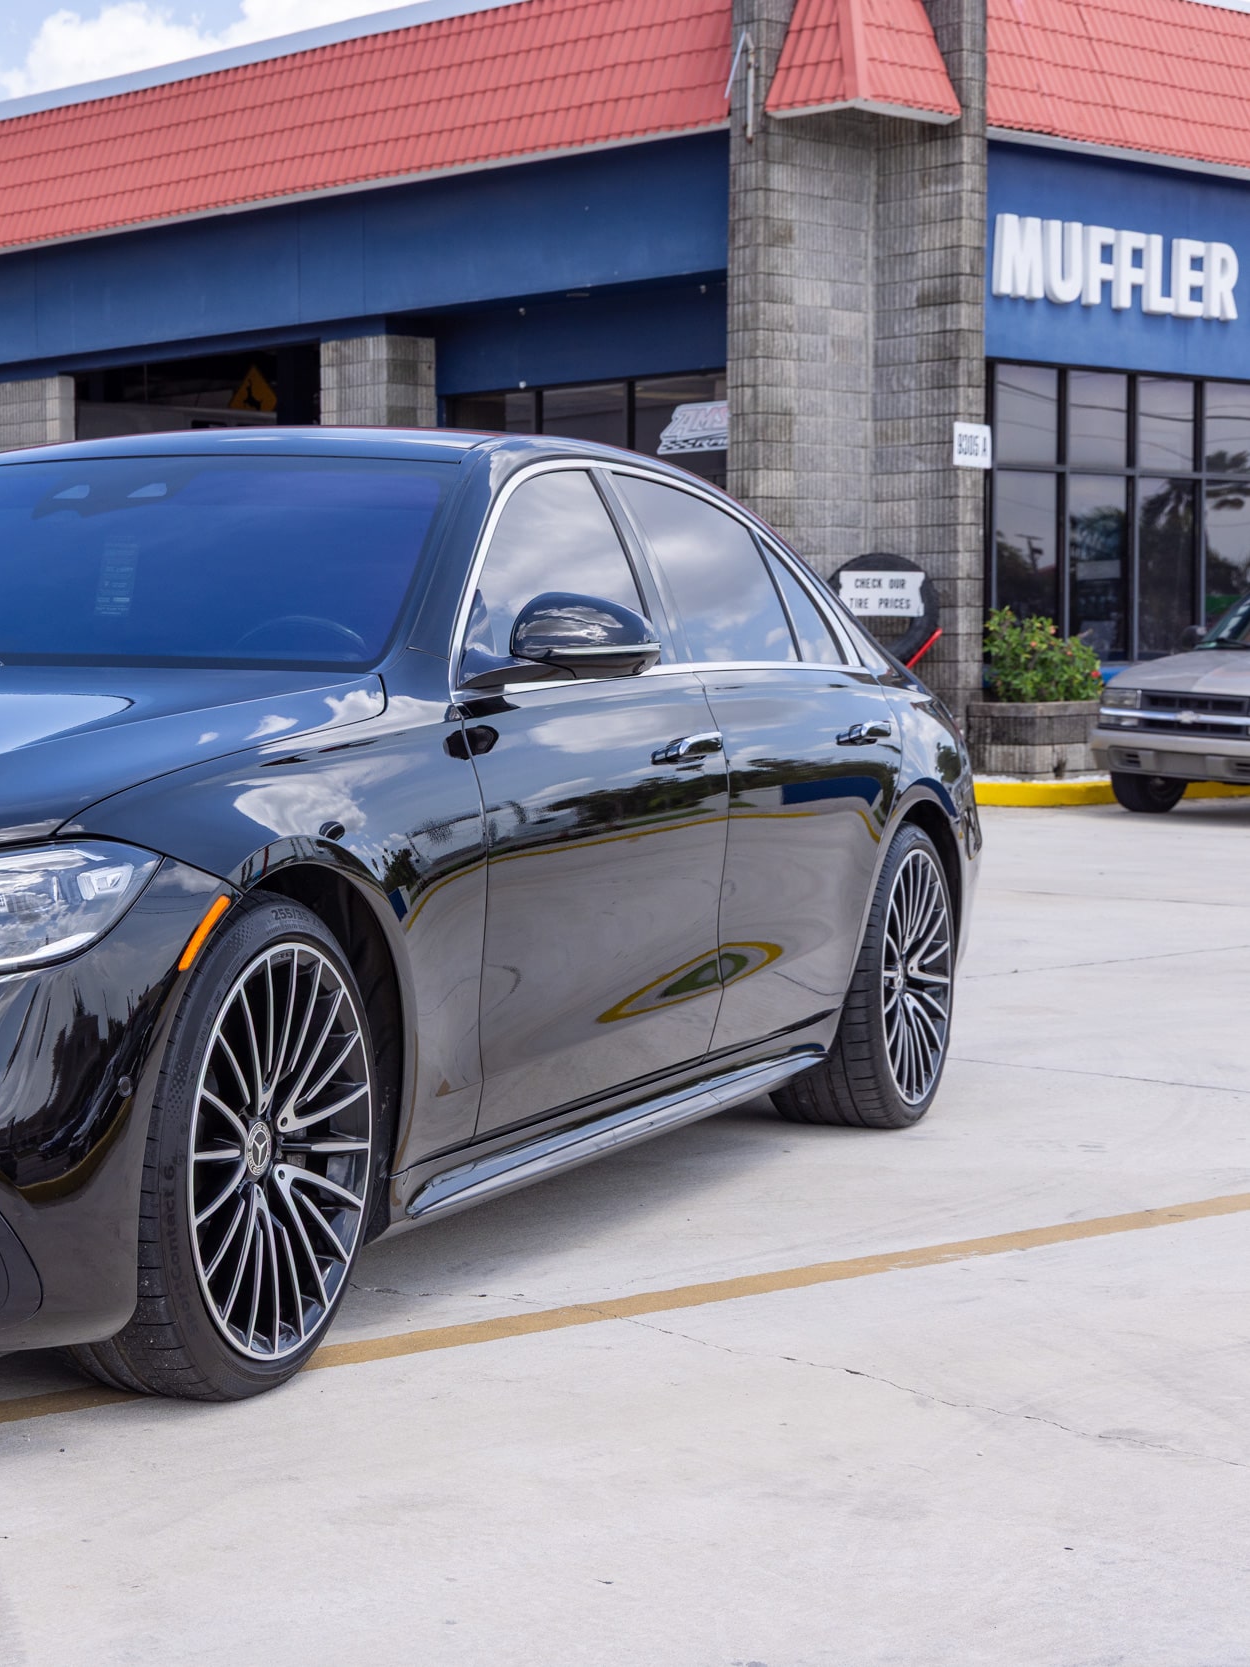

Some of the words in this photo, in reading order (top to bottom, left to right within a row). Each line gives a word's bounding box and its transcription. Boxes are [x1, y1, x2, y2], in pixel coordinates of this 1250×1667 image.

[992, 212, 1239, 322] MUFFLER
[854, 578, 882, 589] CHECK
[888, 578, 906, 589] OUR
[849, 597, 869, 609] TIRE
[877, 597, 911, 609] PRICES
